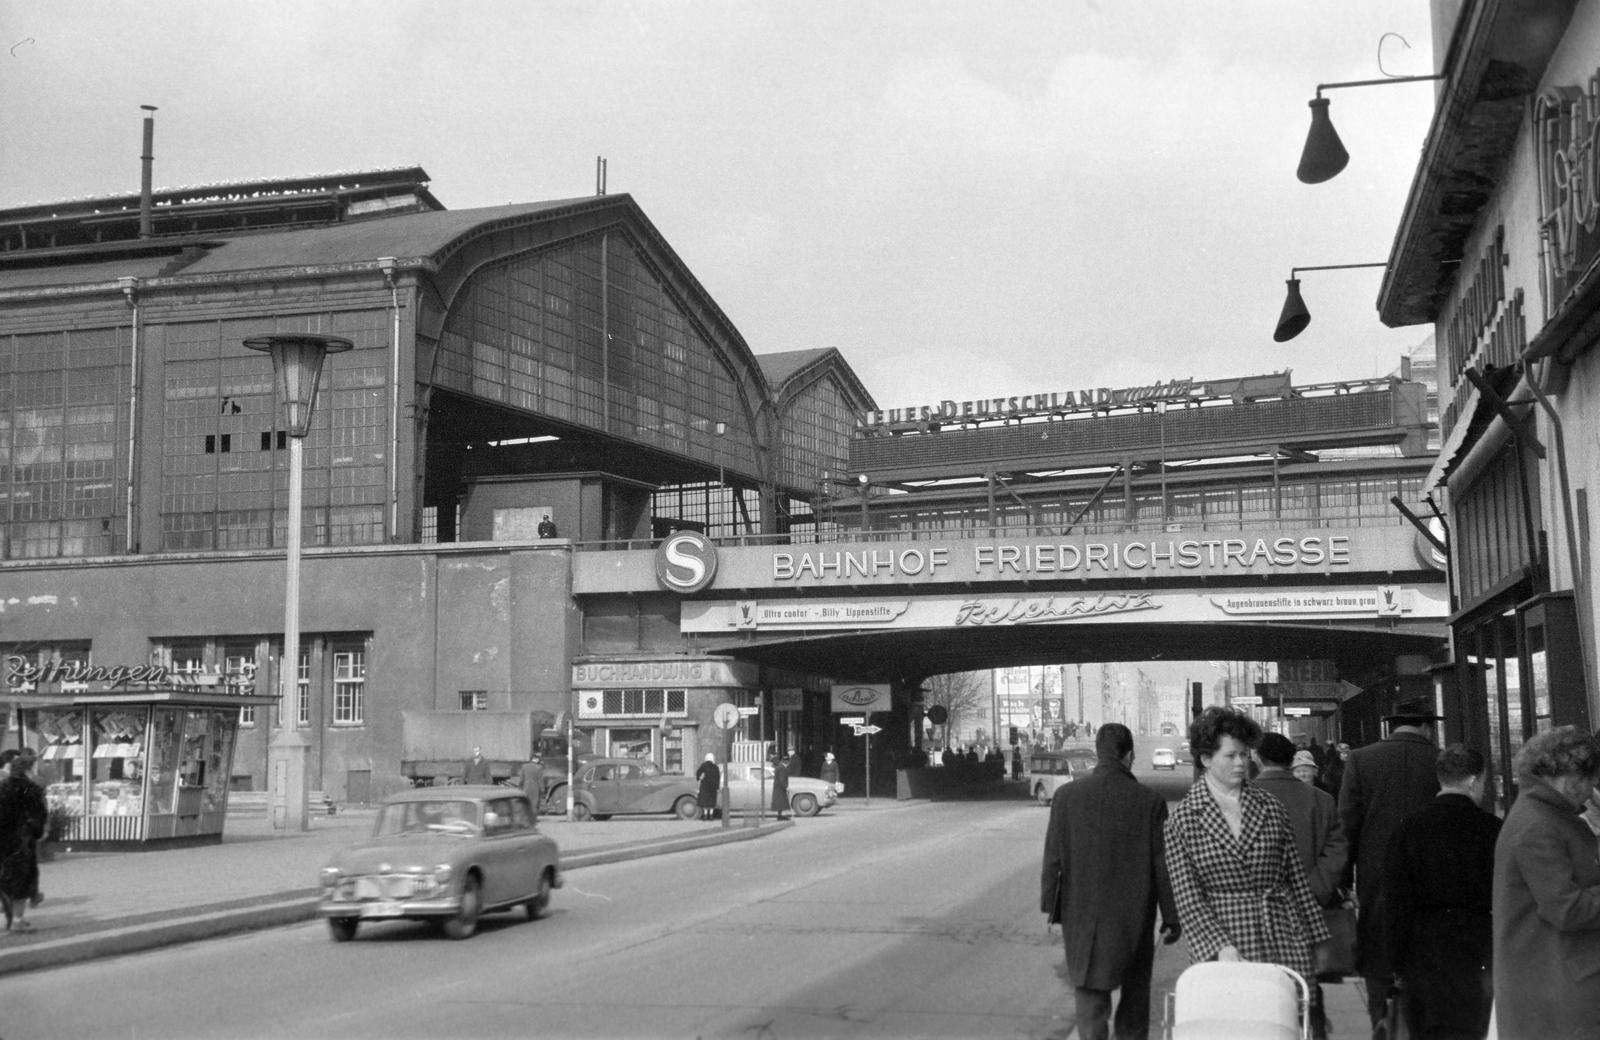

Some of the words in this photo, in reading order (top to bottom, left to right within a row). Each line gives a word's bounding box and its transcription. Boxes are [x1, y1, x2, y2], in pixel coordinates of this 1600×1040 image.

[854, 404, 932, 427] NEUES
[940, 387, 1113, 419] DEUTSCHLAND
[665, 535, 706, 587] S
[773, 548, 948, 580] BAHNHOF
[975, 535, 1350, 573] FRIEDRICHSTRASSE
[846, 606, 891, 619] Lippenstifte
[1227, 597, 1292, 609] Augenbrauenstifte
[1294, 598, 1301, 608] in
[1303, 596, 1334, 608] schwarz
[1336, 595, 1357, 607] braun
[1359, 597, 1376, 608] grau
[575, 664, 703, 682] BUCHHANDLUNG
